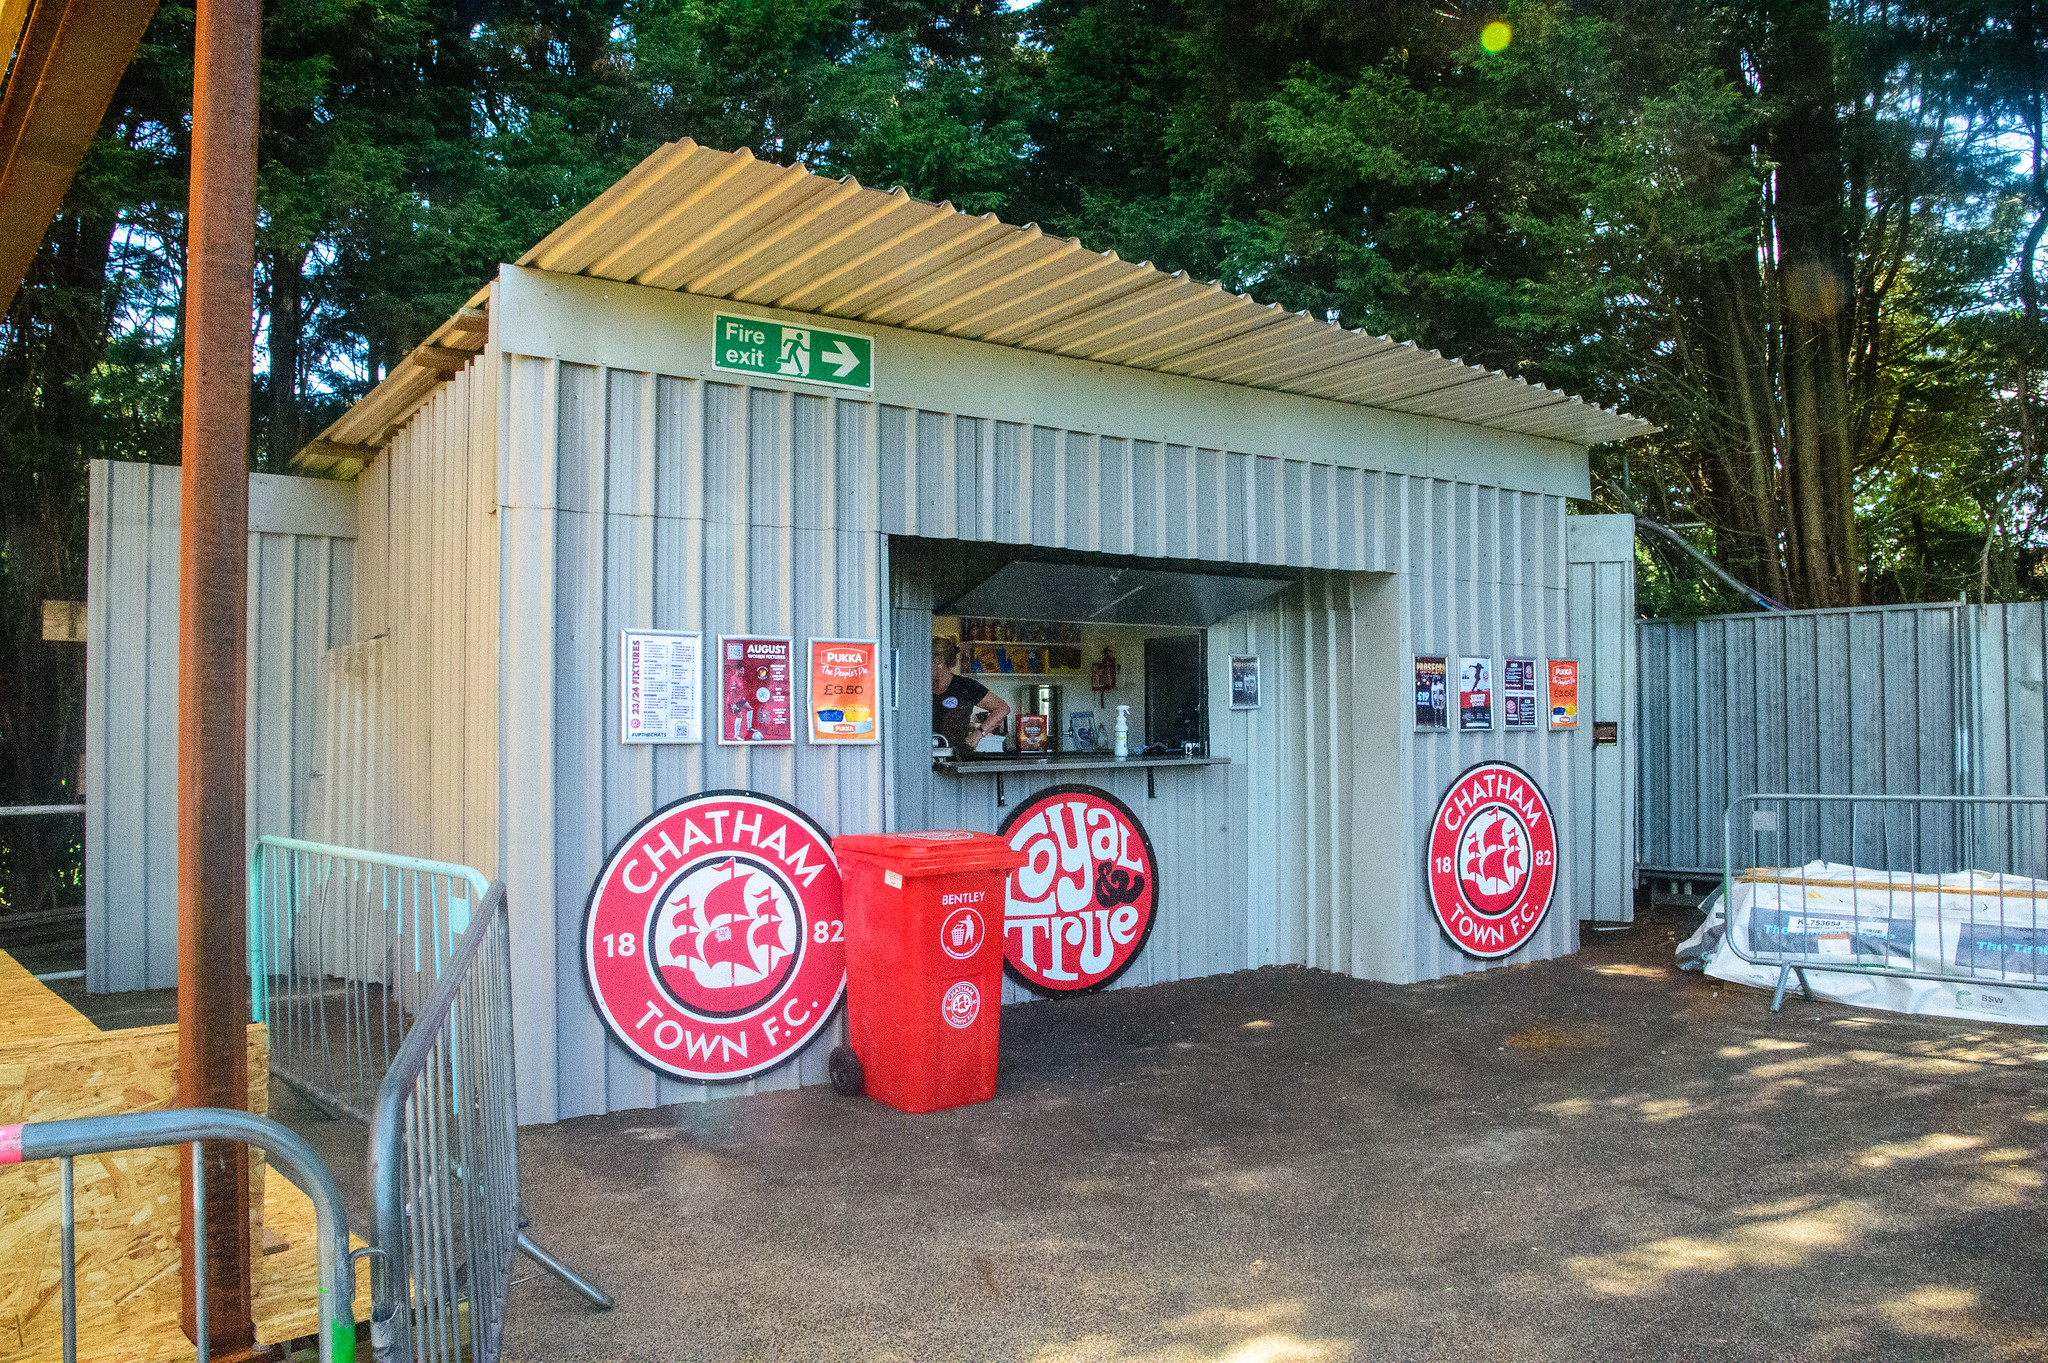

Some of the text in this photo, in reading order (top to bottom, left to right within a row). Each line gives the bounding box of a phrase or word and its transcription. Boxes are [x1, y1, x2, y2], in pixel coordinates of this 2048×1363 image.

[725, 321, 765, 345] Fire
[725, 347, 764, 367] exit
[747, 644, 787, 655] AUGUST
[827, 652, 863, 663] PUKKA
[631, 639, 641, 715] 23/24 FIXTURES
[824, 684, 864, 696] £3.50
[1444, 774, 1543, 831] CHATHAM
[622, 810, 826, 894] CHATHAM
[1535, 850, 1552, 866] 82
[1435, 856, 1452, 874] 18
[1094, 861, 1145, 909] &
[941, 891, 985, 906] BENTLEY
[813, 920, 845, 943] 82
[1449, 902, 1539, 946] TOWN F.C.
[602, 933, 636, 957] 18
[1976, 941, 2008, 952] The
[948, 985, 974, 1001] CHATHAM
[1981, 994, 2004, 1004] BSW
[635, 997, 818, 1062] TOWN F.C.
